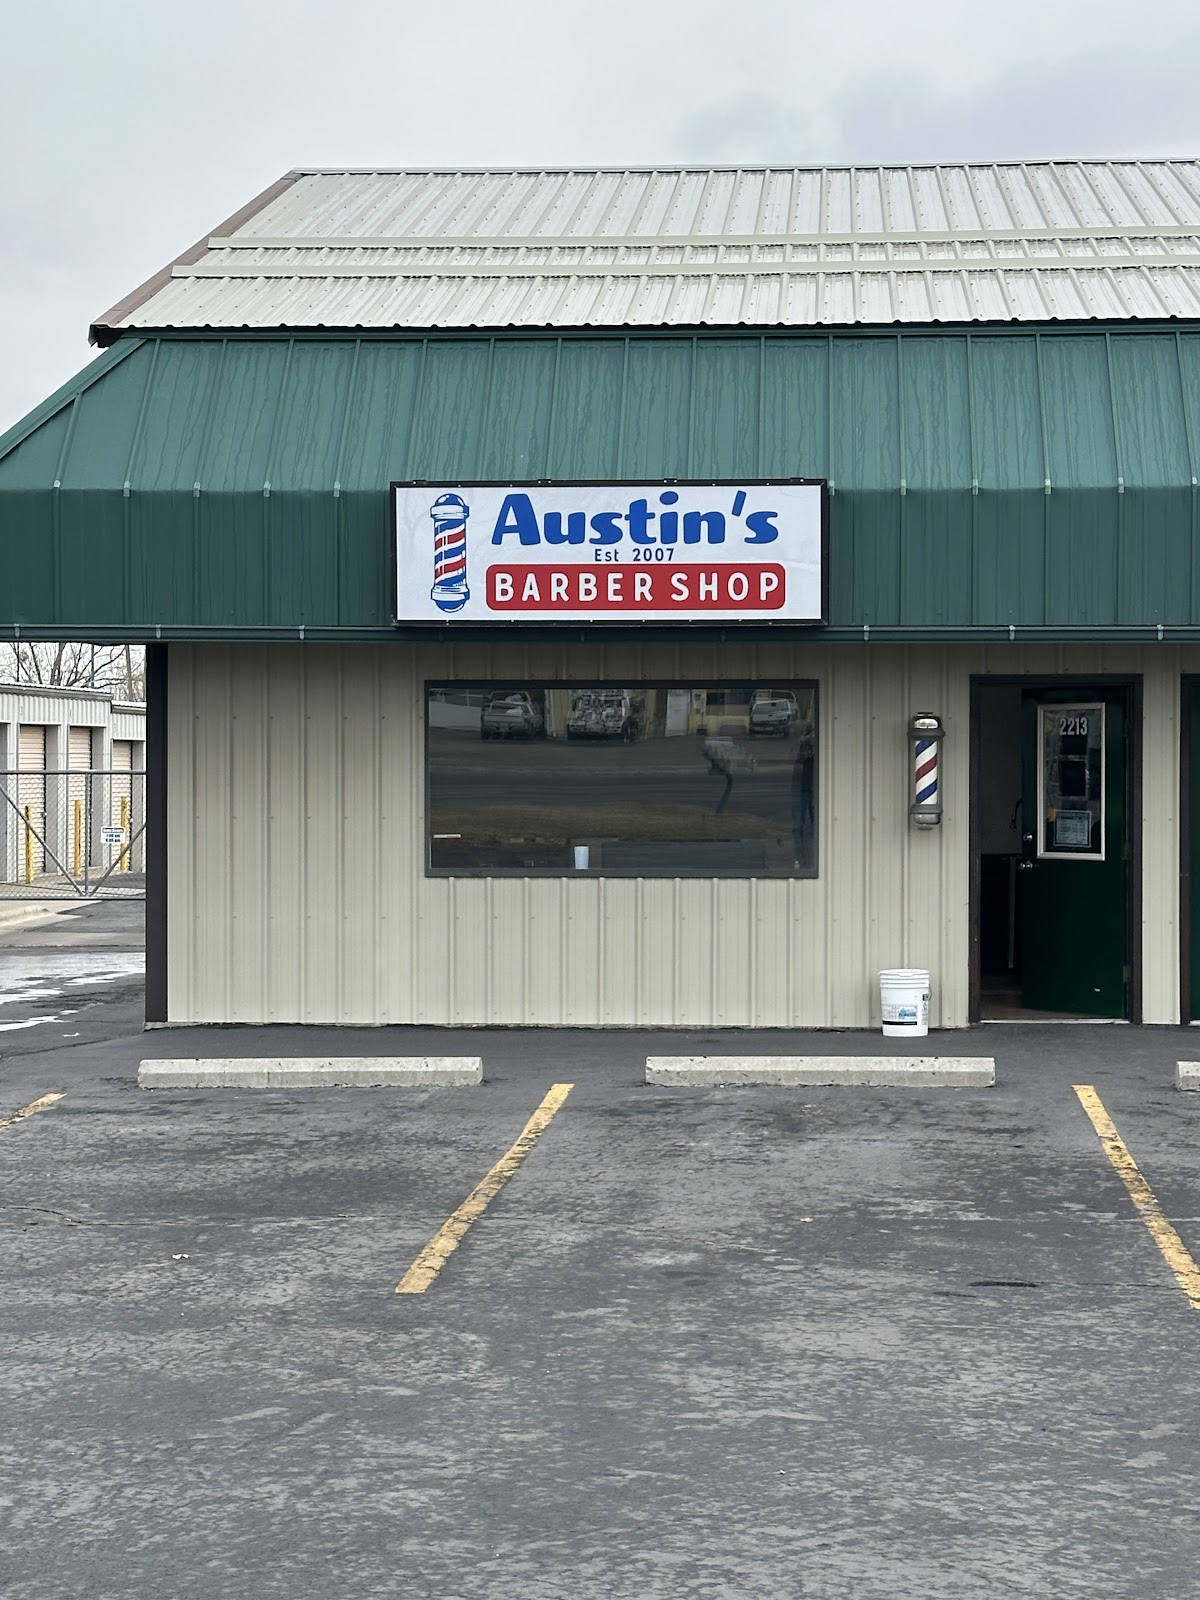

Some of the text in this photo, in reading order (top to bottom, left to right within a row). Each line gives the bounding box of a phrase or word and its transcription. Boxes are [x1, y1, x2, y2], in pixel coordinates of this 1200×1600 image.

[492, 490, 780, 546] Austin's
[594, 548, 675, 563] Est 2007
[494, 572, 780, 602] BARBER SHOP
[1059, 717, 1088, 736] 2213
